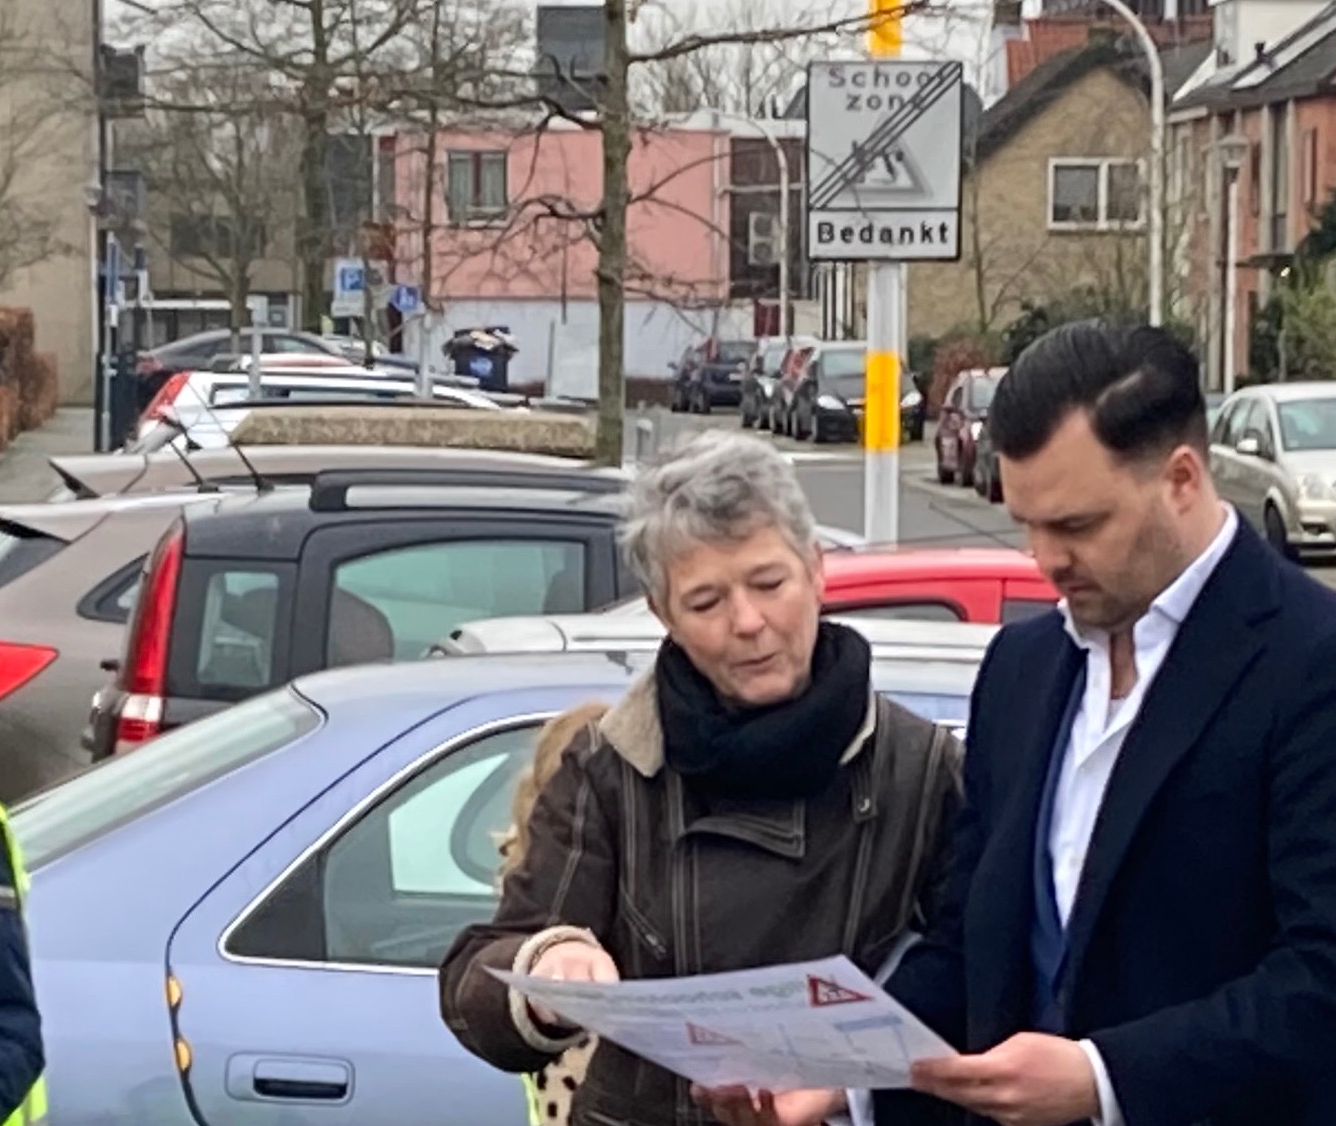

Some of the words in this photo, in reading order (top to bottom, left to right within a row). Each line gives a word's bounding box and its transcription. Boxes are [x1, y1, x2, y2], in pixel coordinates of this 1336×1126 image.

[828, 64, 942, 88] Schoo
[845, 93, 906, 112] zon
[817, 221, 947, 244] Bedankt
